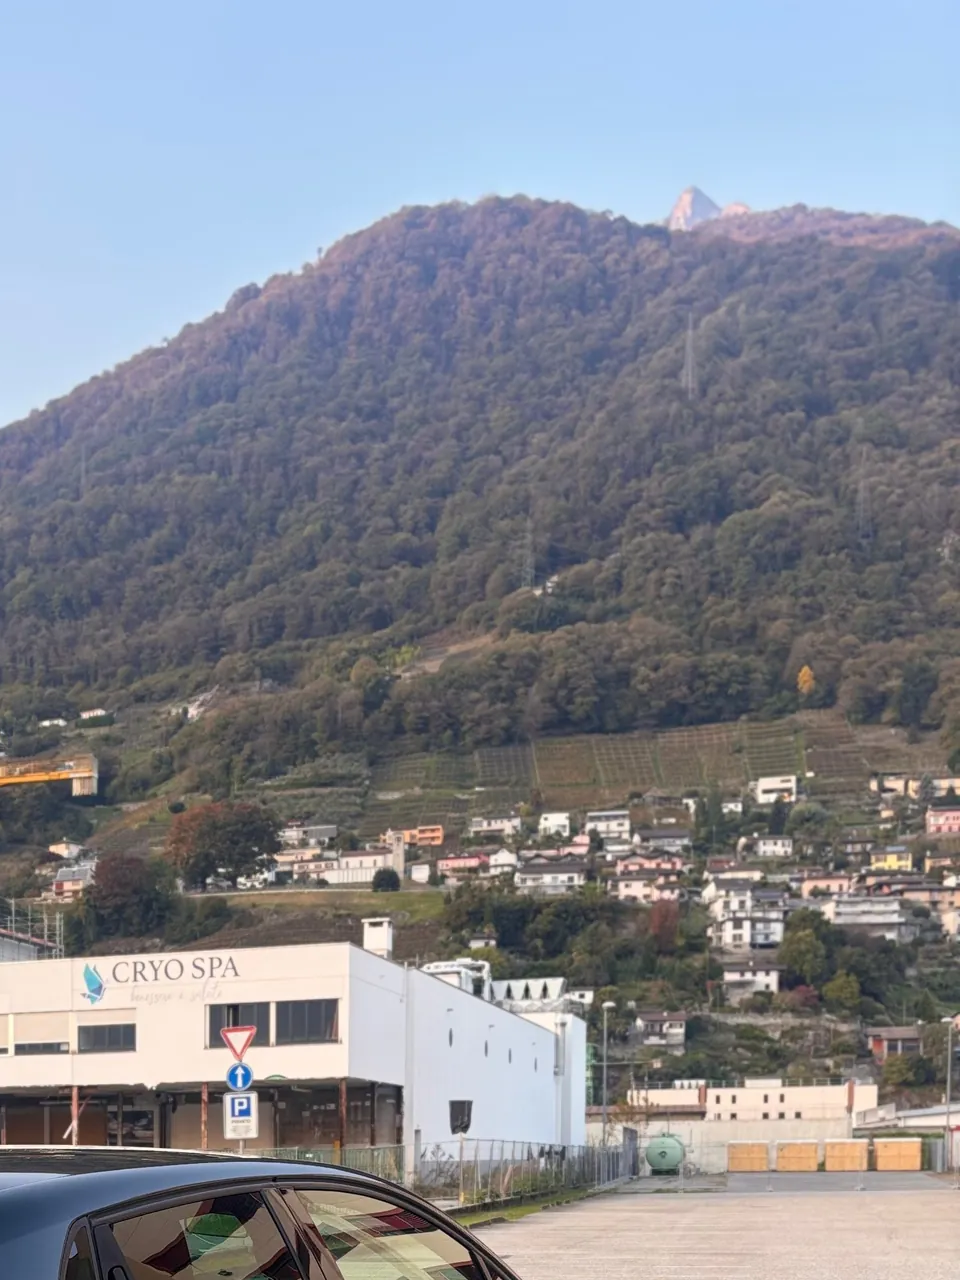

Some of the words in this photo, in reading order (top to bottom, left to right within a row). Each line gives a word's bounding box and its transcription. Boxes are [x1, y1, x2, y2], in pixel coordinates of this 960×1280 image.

[112, 958, 184, 983] CRYO
[191, 956, 240, 979] SPA
[234, 1098, 248, 1116] P
